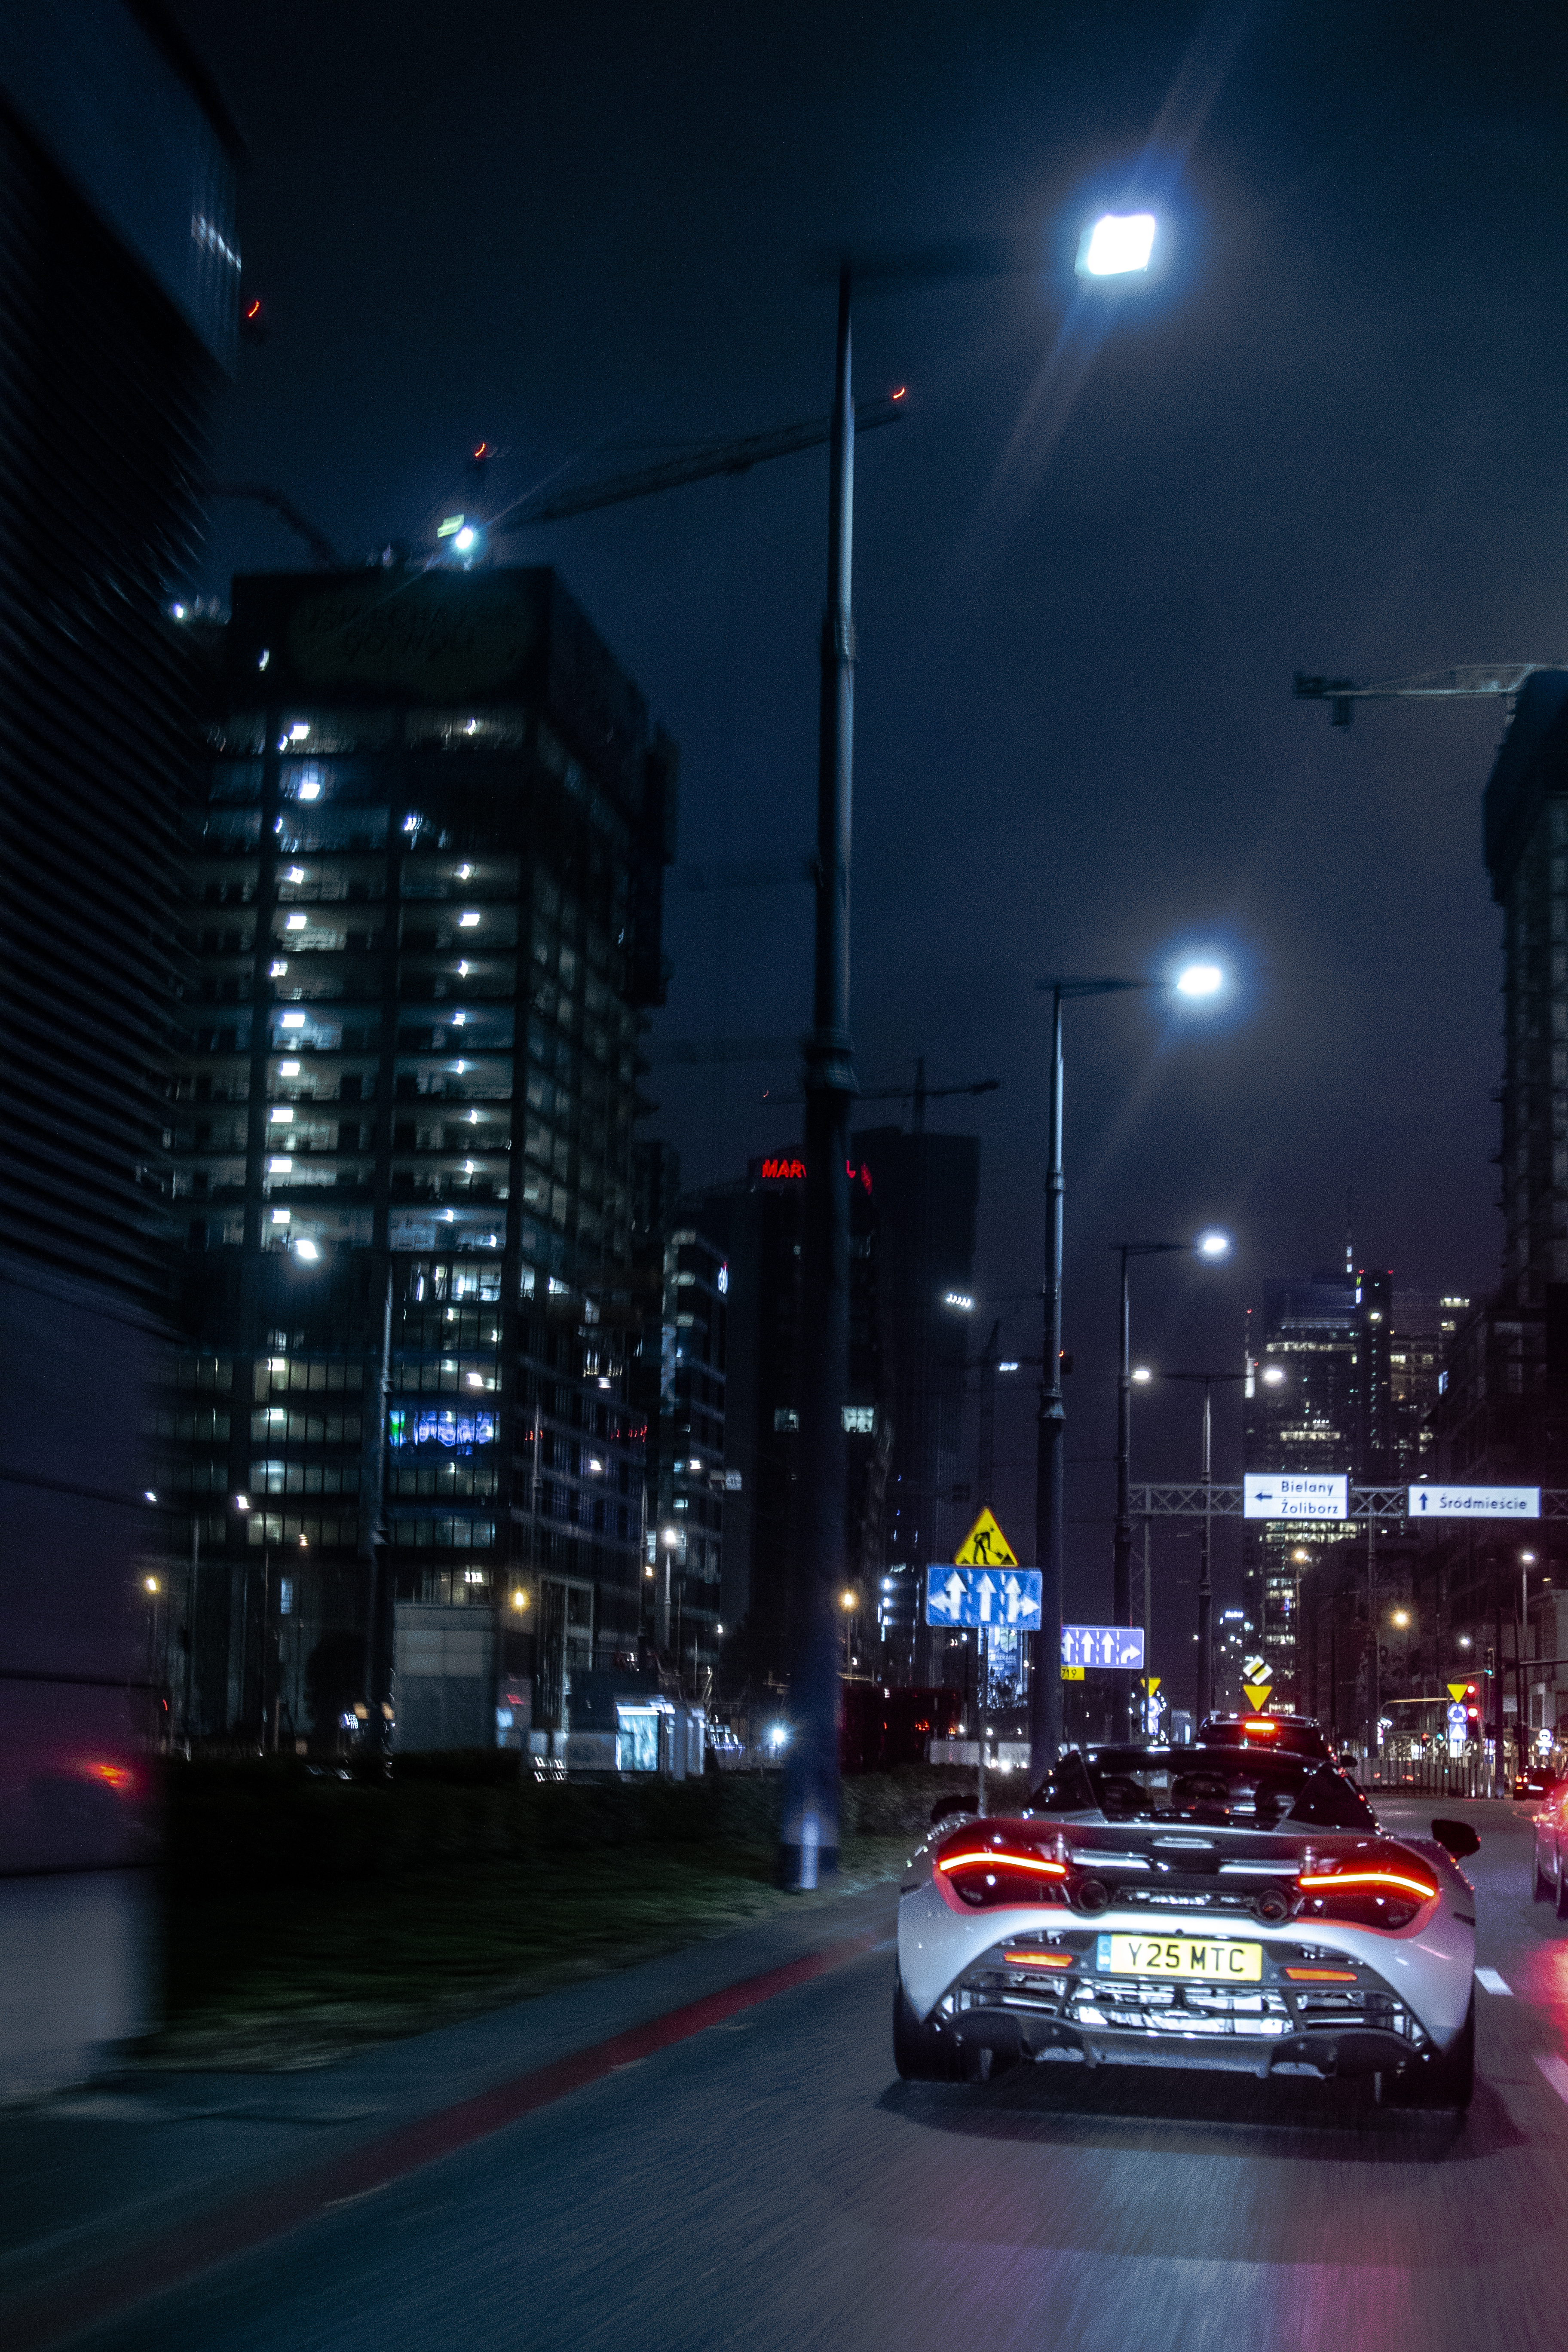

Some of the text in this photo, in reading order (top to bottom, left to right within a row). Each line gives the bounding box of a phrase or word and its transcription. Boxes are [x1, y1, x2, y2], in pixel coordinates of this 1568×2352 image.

[1281, 1480, 1334, 1496] Bielany
[1281, 1498, 1338, 1514] Żoliborz
[1439, 1493, 1527, 1510] Śródmieście
[1128, 1942, 1245, 1973] Y25 MTC
